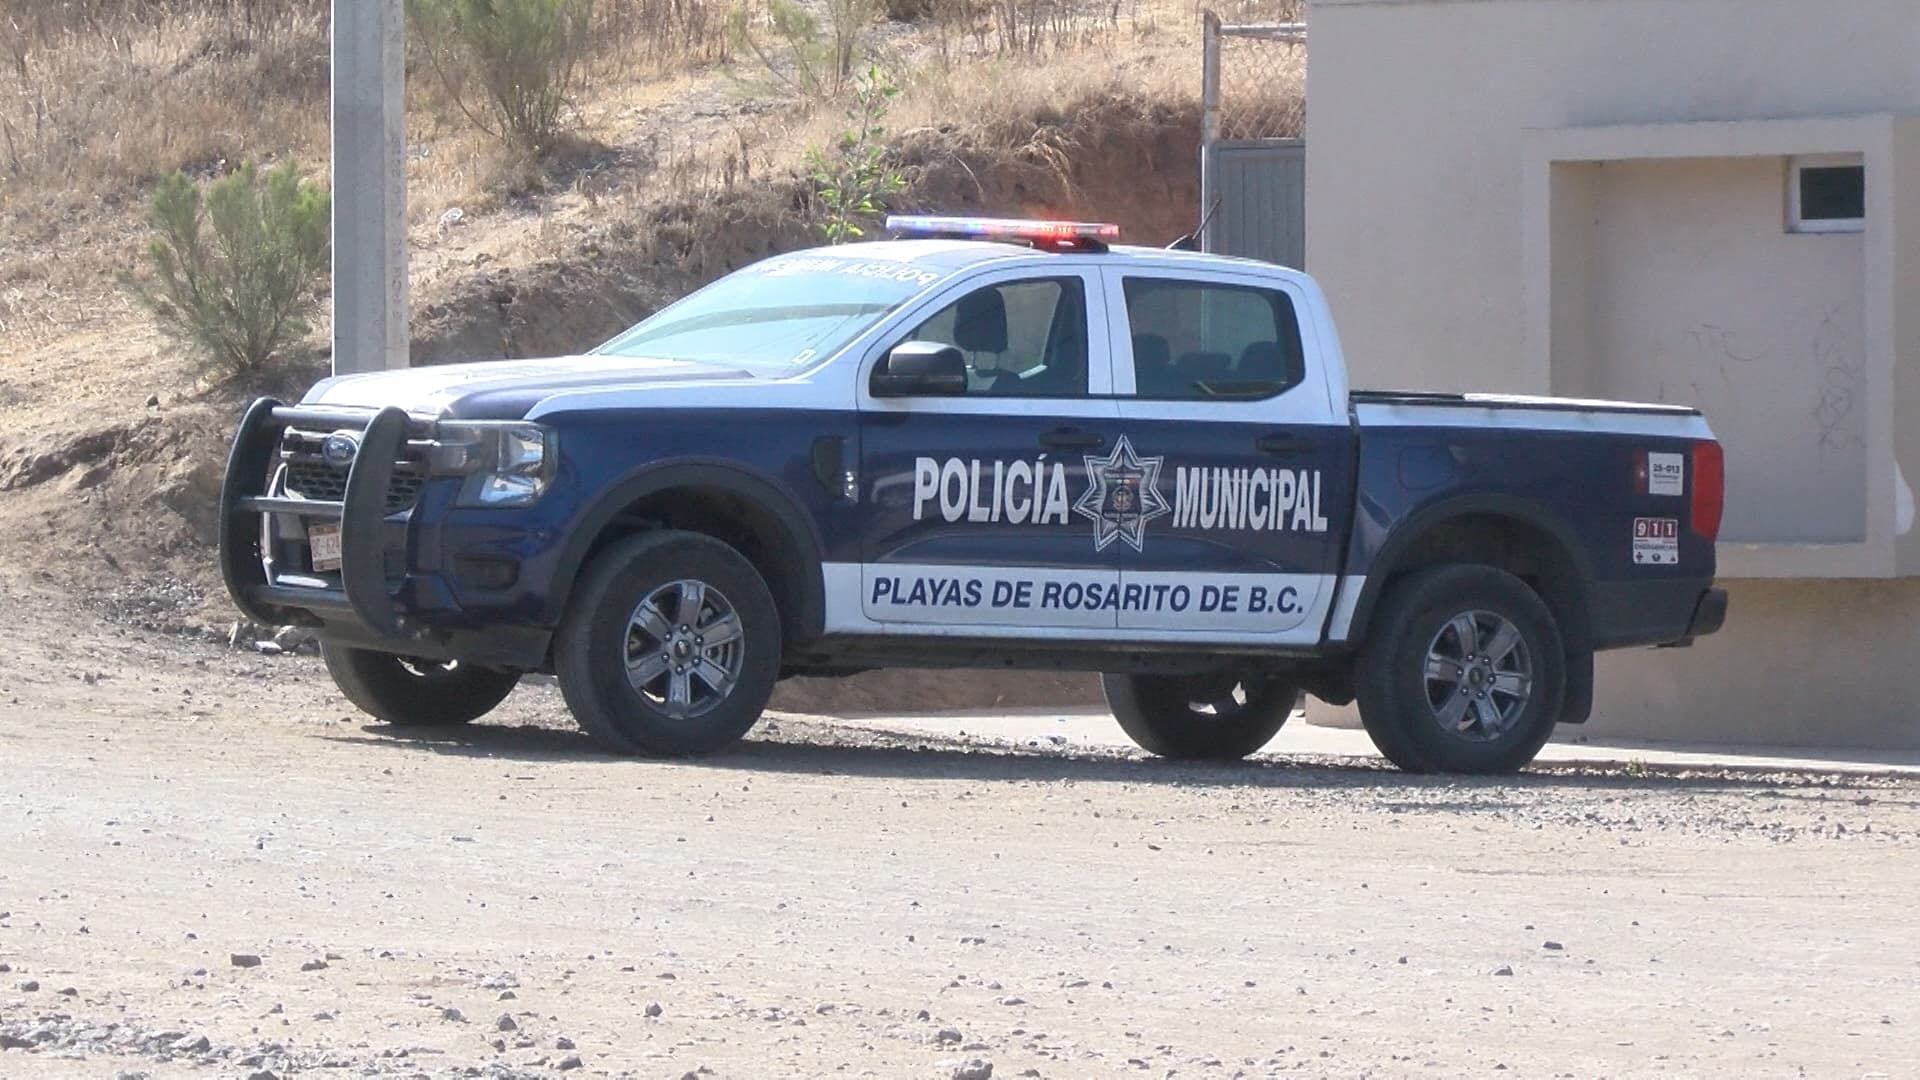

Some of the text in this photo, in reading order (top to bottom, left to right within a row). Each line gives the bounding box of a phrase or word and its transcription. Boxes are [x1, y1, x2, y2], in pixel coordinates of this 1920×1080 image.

[912, 453, 1328, 533] POLICÍA MUNICIPAL
[1637, 522, 1673, 537] 911
[872, 577, 1304, 614] PLAYAS DE ROSARITO DE B.C.
